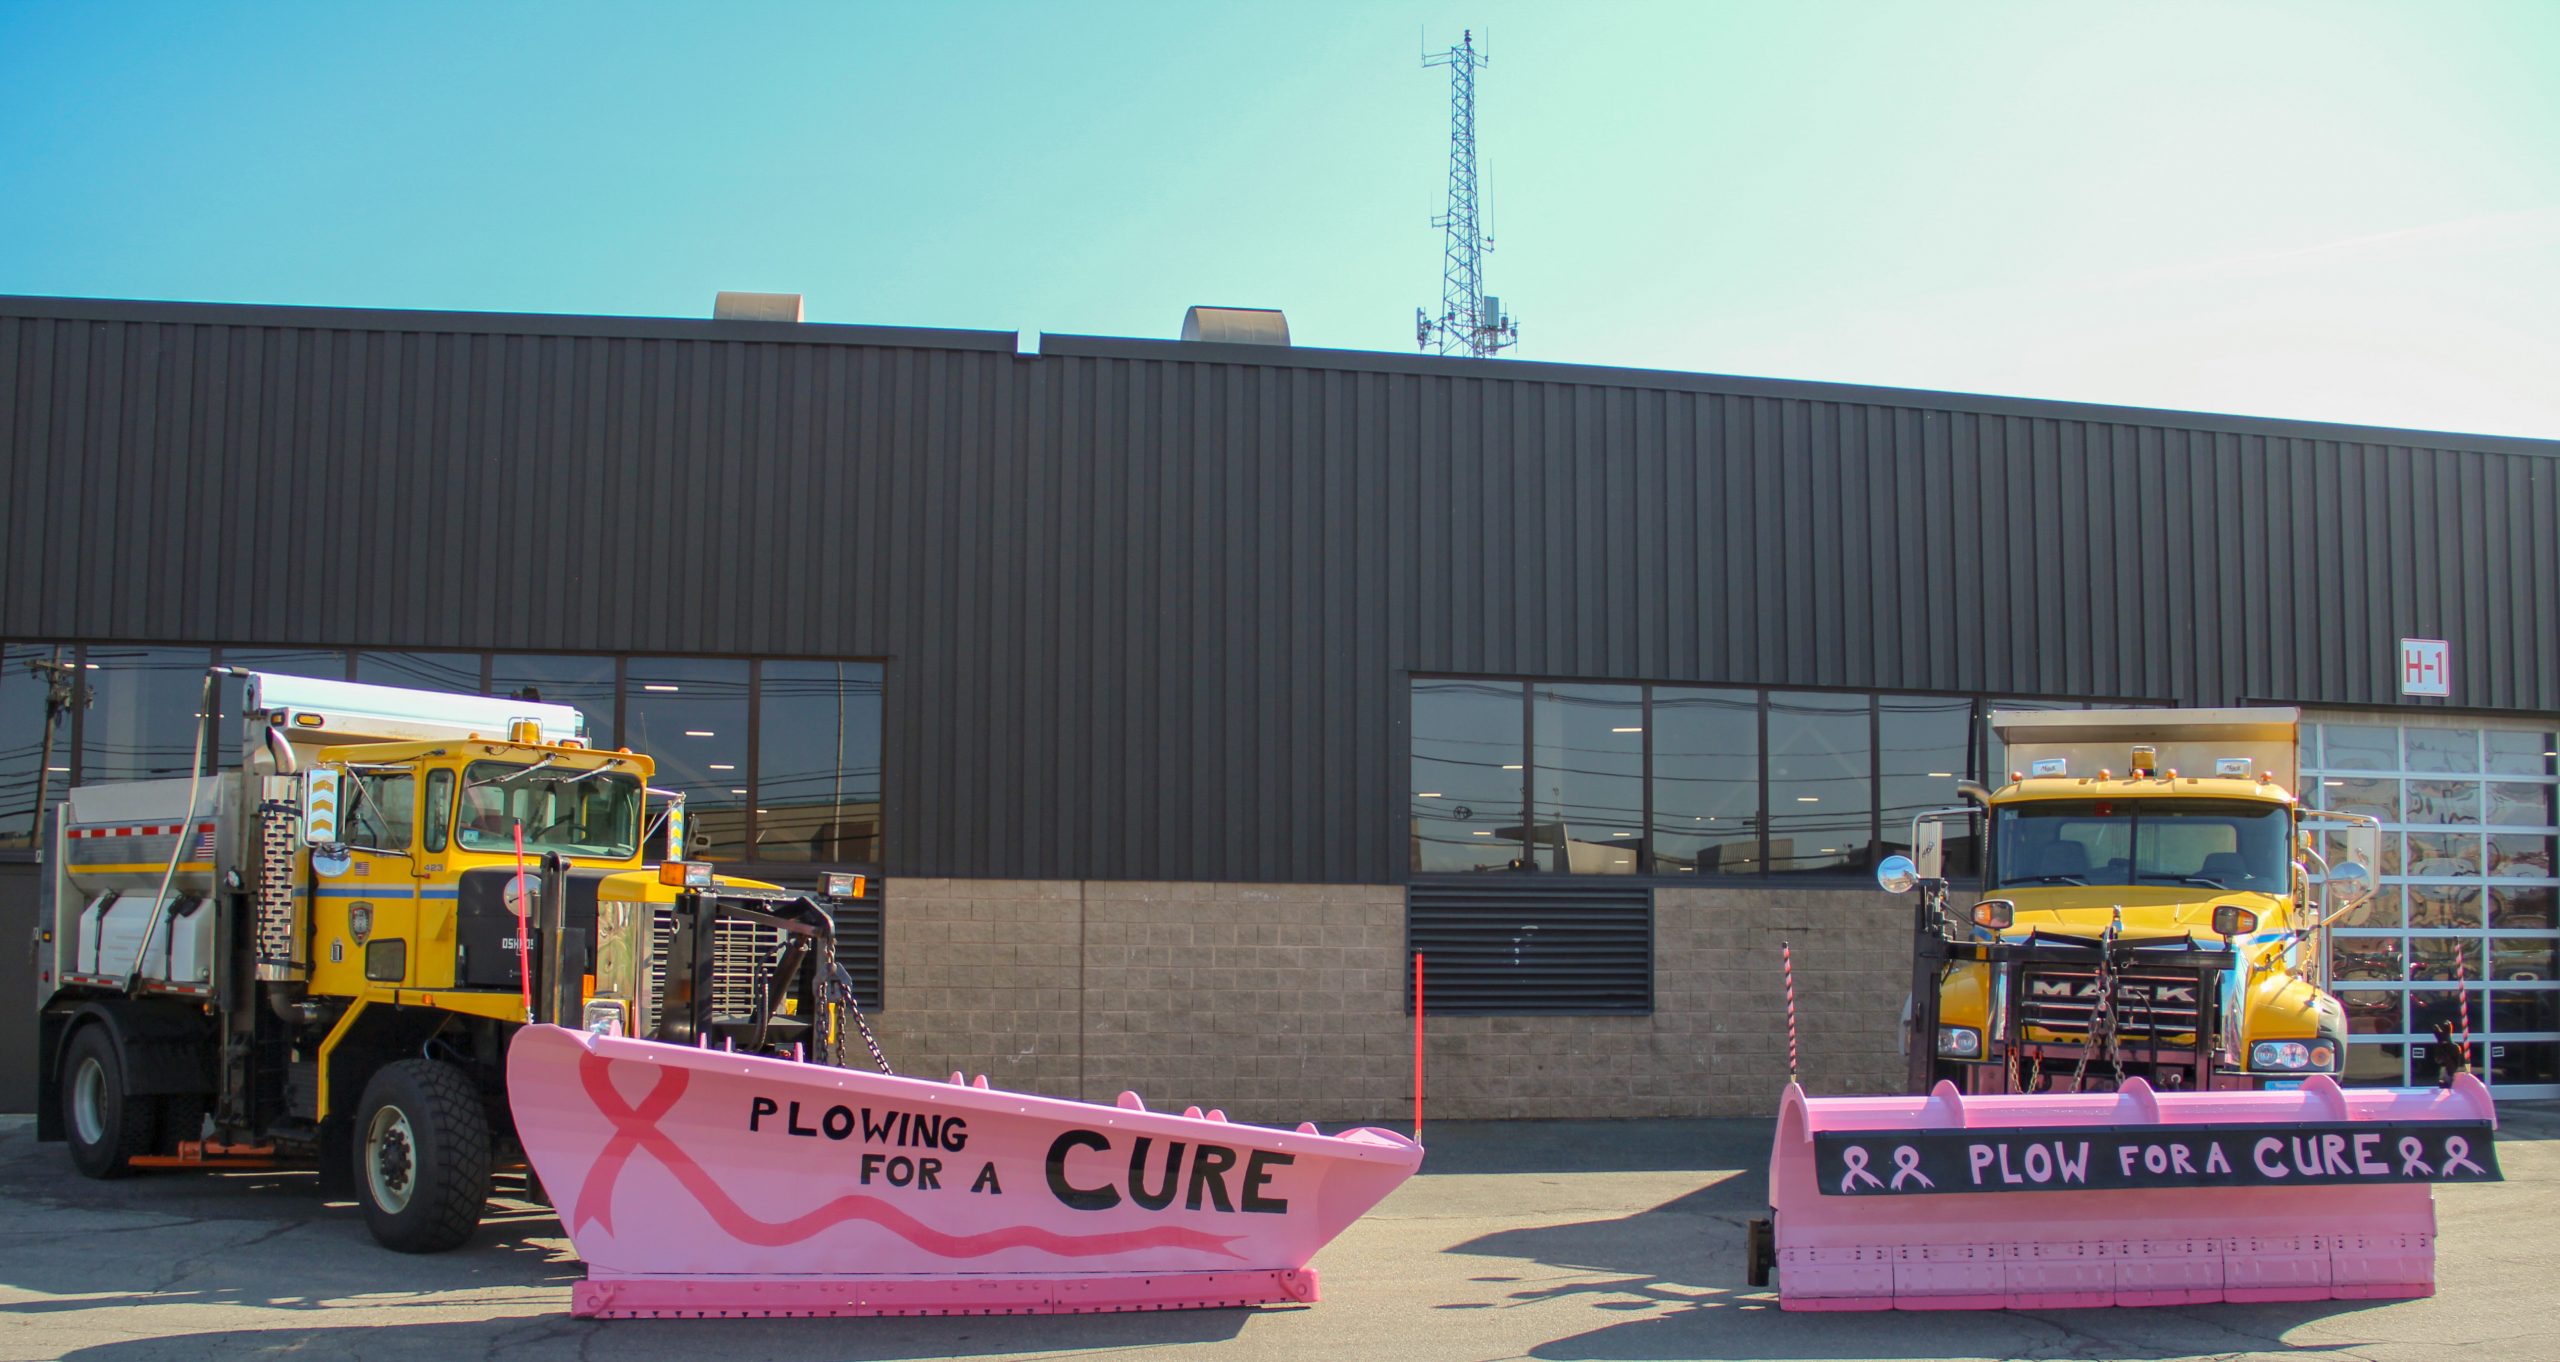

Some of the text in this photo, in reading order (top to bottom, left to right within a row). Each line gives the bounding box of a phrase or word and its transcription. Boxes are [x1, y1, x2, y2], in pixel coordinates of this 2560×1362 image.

[2405, 649, 2443, 685] H-1
[749, 1096, 968, 1152] PLOWING
[860, 1129, 1295, 1214] FOR A CURE
[1969, 1133, 2389, 1185] PLOW FOR A CURE
